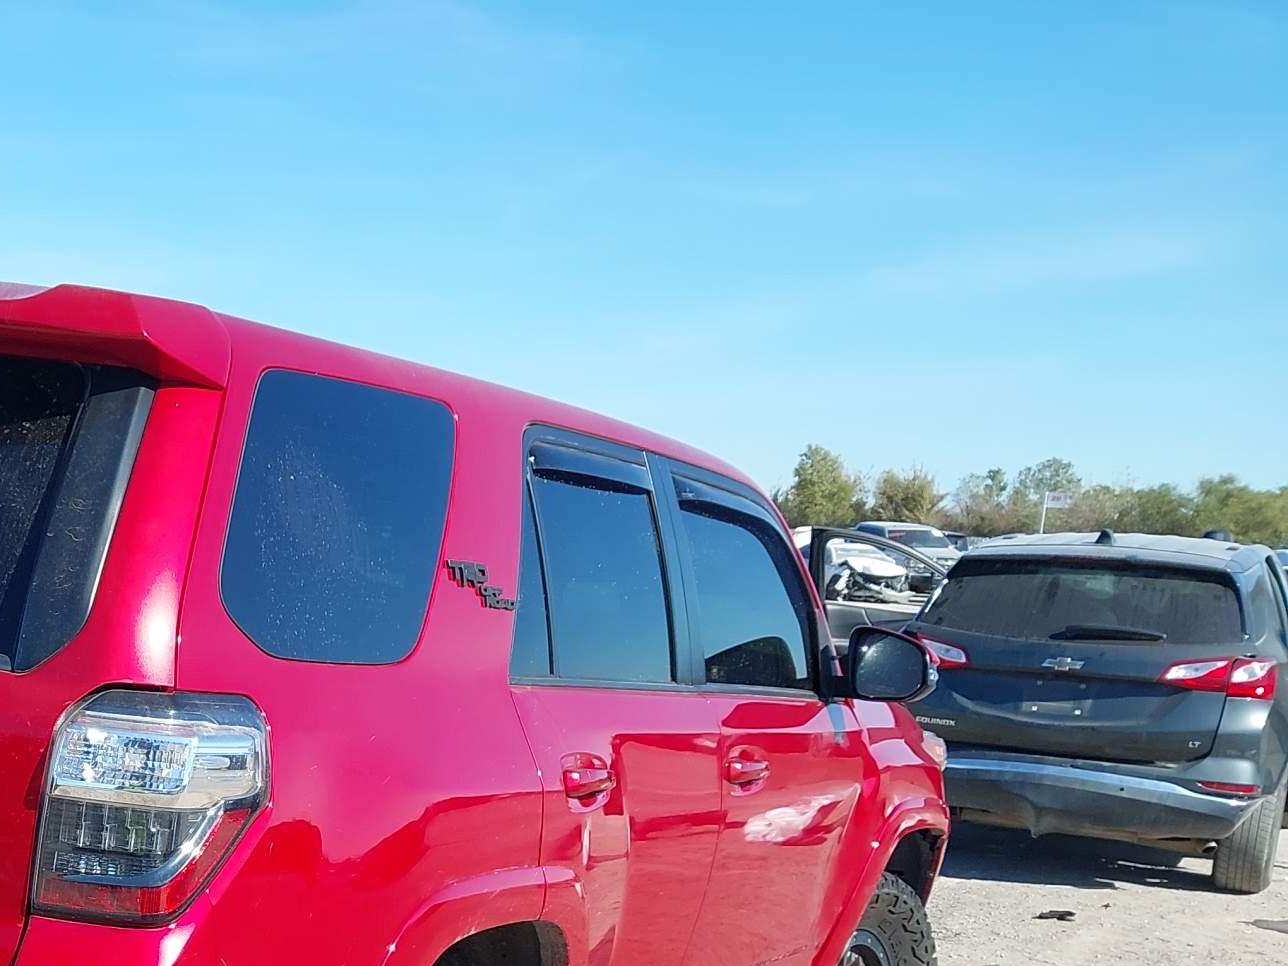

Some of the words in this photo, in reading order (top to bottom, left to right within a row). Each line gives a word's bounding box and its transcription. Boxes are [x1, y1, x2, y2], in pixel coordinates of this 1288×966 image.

[446, 560, 488, 588] TRD
[915, 715, 956, 727] EQUINOX
[1187, 740, 1202, 749] LT
